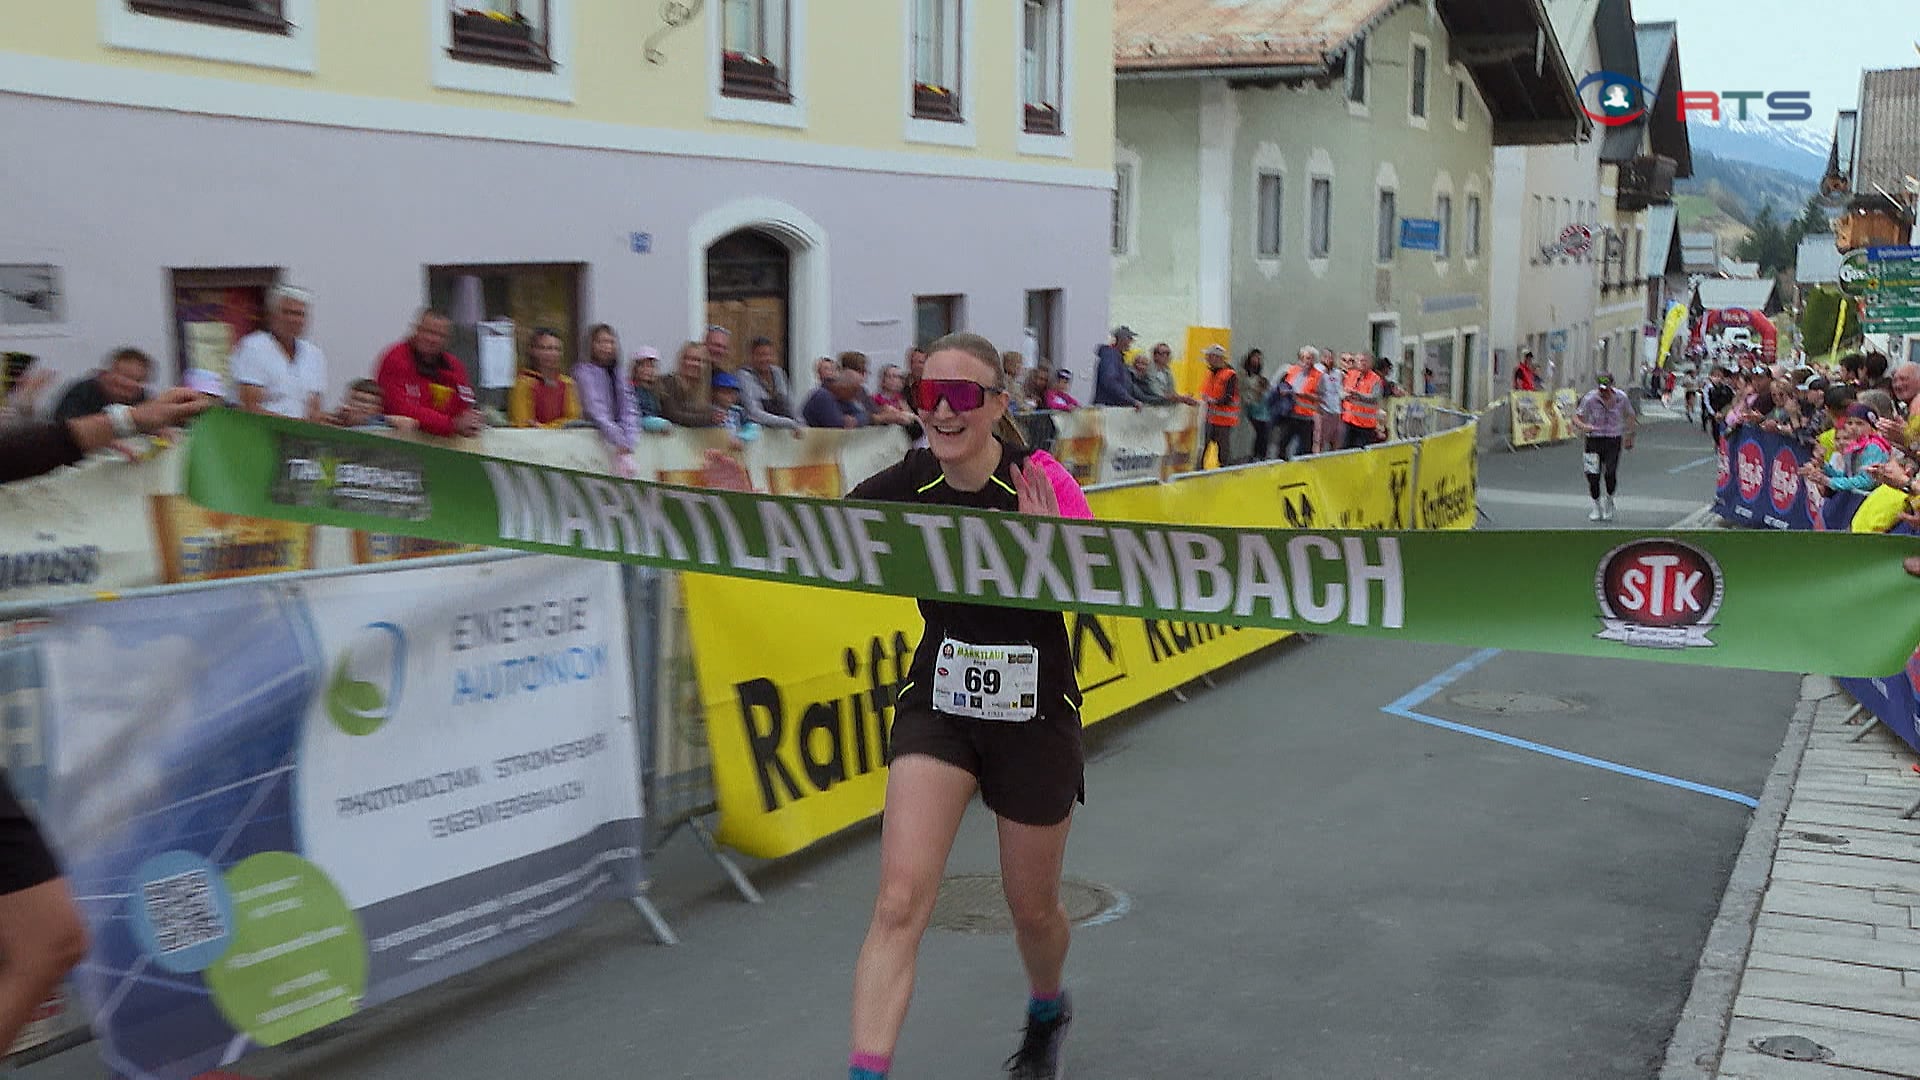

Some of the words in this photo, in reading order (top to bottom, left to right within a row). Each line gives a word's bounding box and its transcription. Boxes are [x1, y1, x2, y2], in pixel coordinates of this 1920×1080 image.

[483, 462, 892, 586] MARKTLAUF
[904, 512, 1406, 629] TAXENBACH
[1618, 554, 1704, 616] STK
[964, 666, 1002, 695] 69
